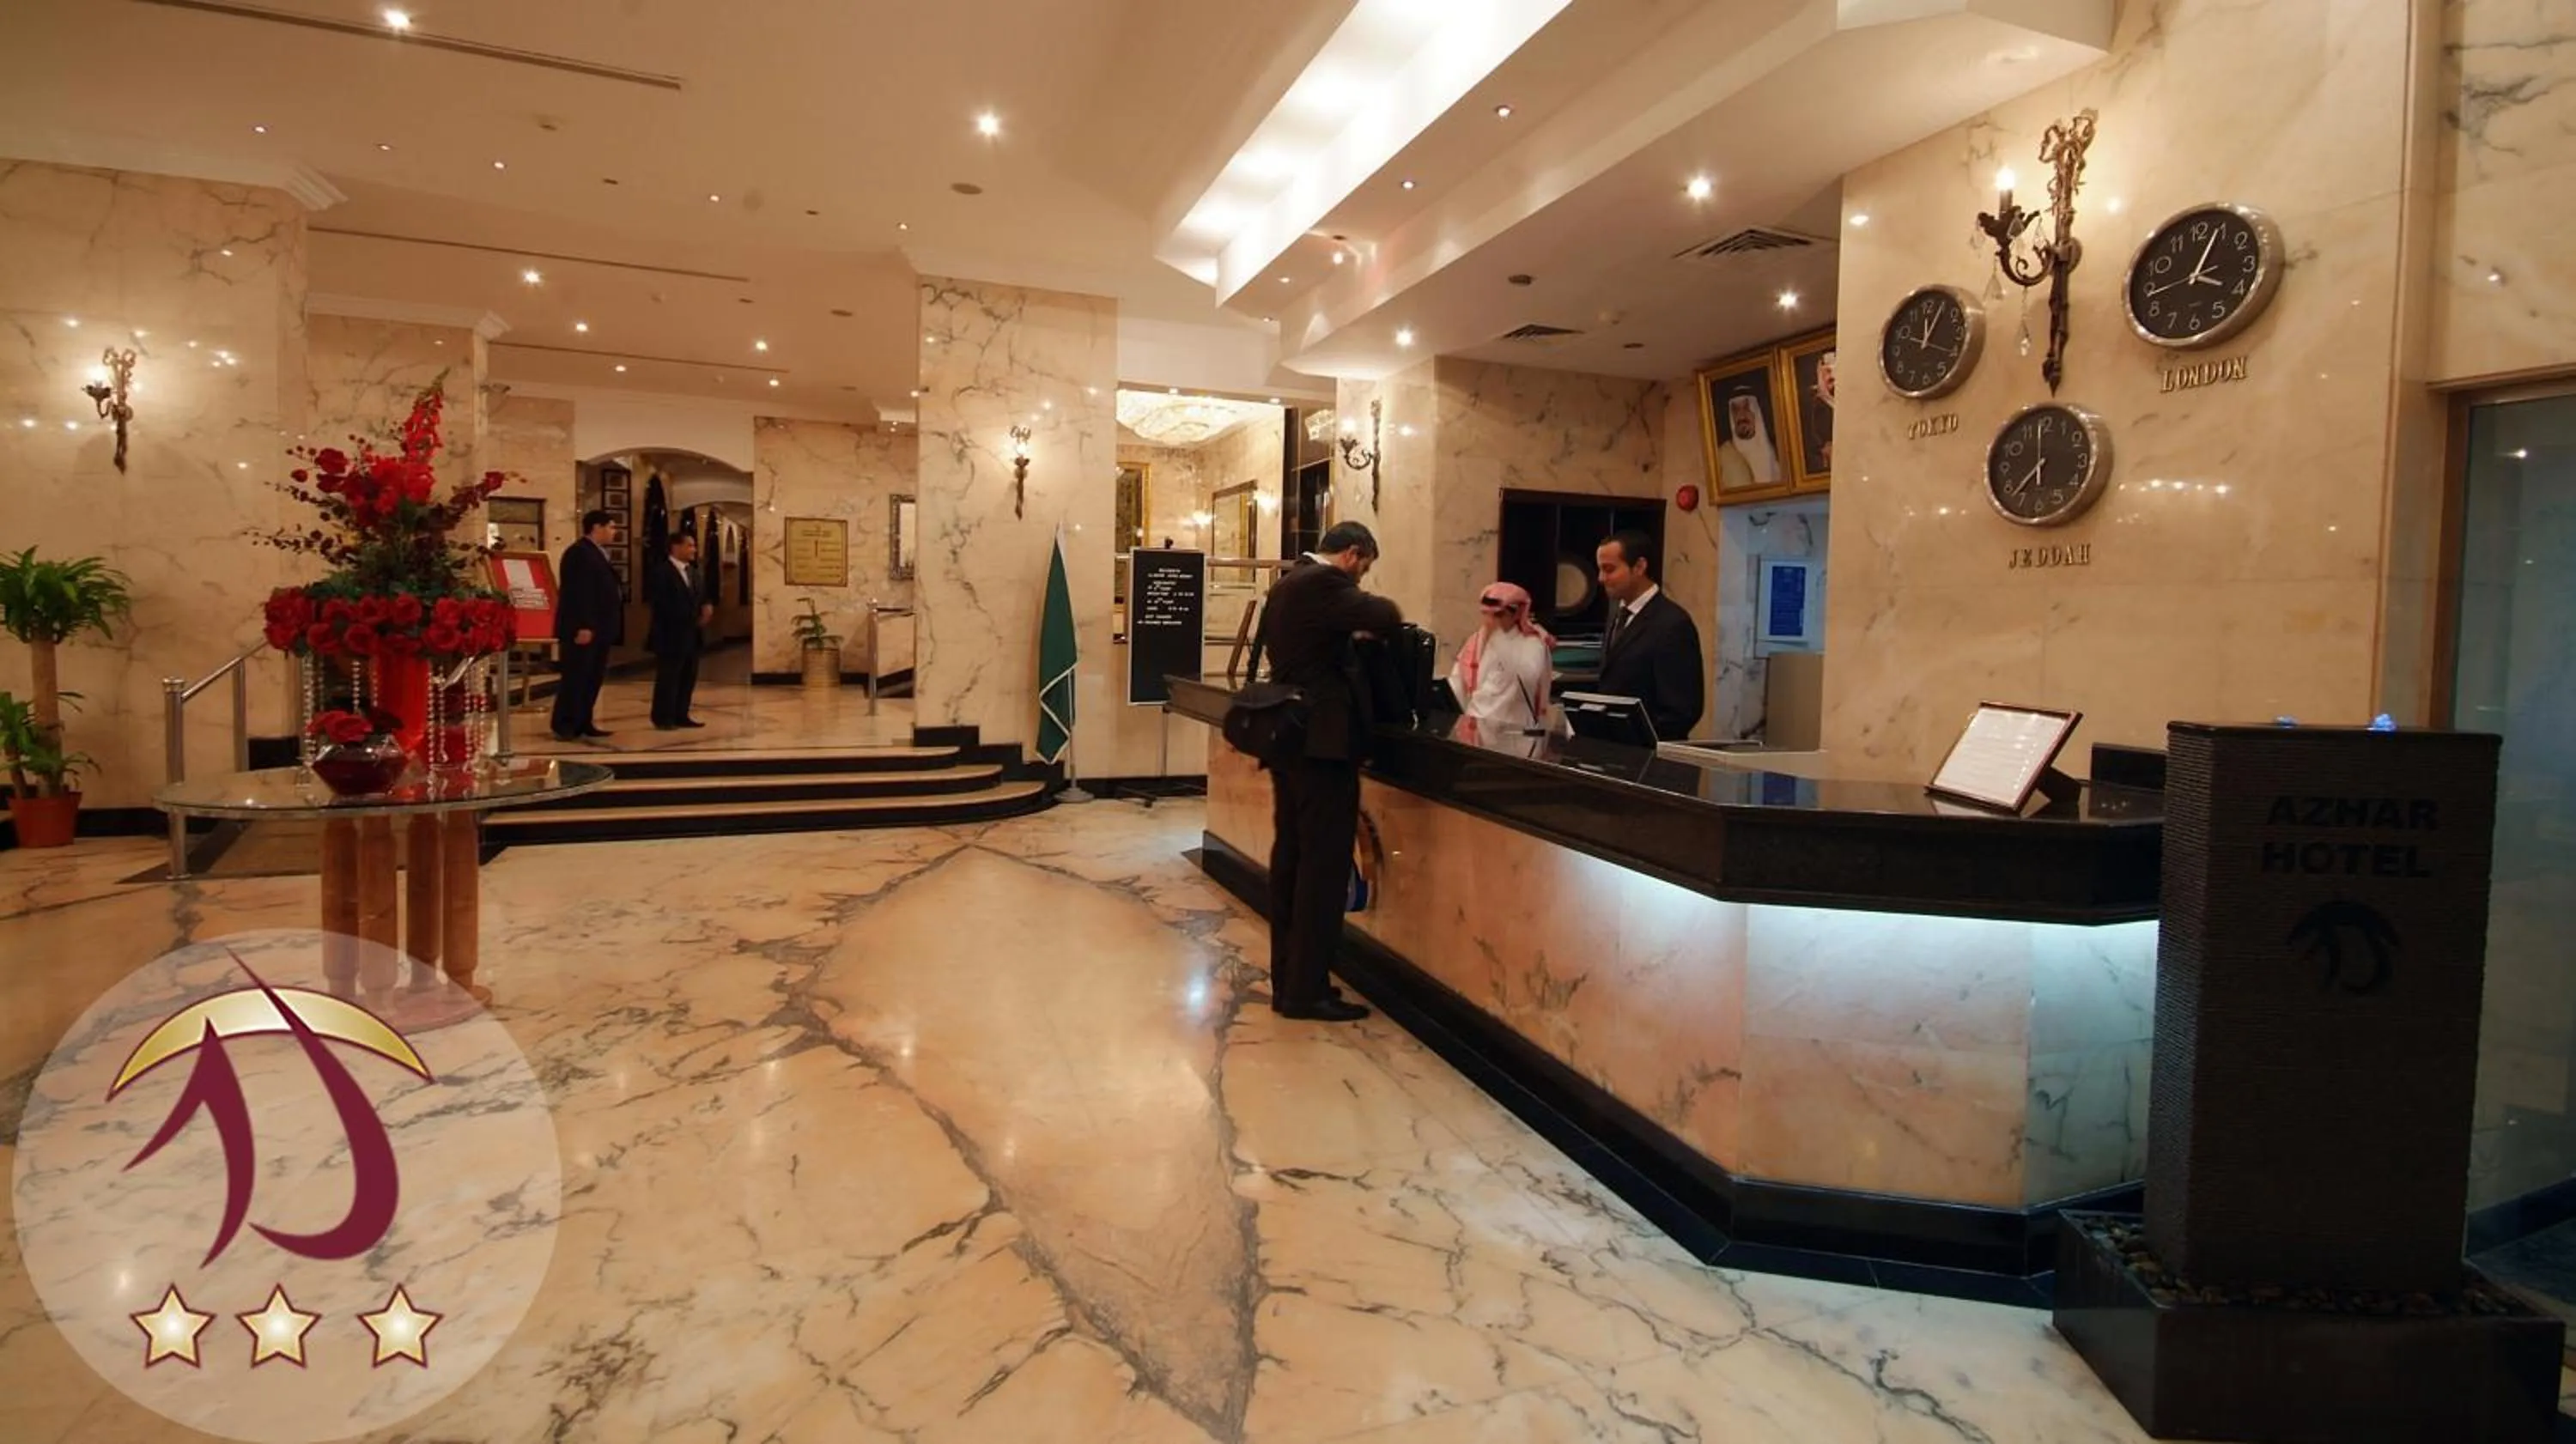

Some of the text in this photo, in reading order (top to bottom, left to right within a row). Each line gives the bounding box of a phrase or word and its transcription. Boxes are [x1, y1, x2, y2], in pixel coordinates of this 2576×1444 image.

[2190, 221, 2209, 242] 12
[2233, 231, 2248, 251] 2
[2170, 234, 2184, 253] 11
[2148, 256, 2172, 276] 10
[2242, 255, 2256, 272] 3
[2232, 278, 2245, 295] 4
[2148, 300, 2160, 317] 8
[2211, 301, 2226, 319] 5
[2166, 312, 2178, 330] 7
[2190, 313, 2201, 331] 6
[1937, 361, 1947, 378] 5
[2160, 356, 2247, 392] LONDON
[1908, 413, 1959, 440] TOKYO
[2008, 543, 2091, 568] JEDDAH
[2267, 795, 2439, 830] AZHAR
[2261, 841, 2433, 877] HOTEL
